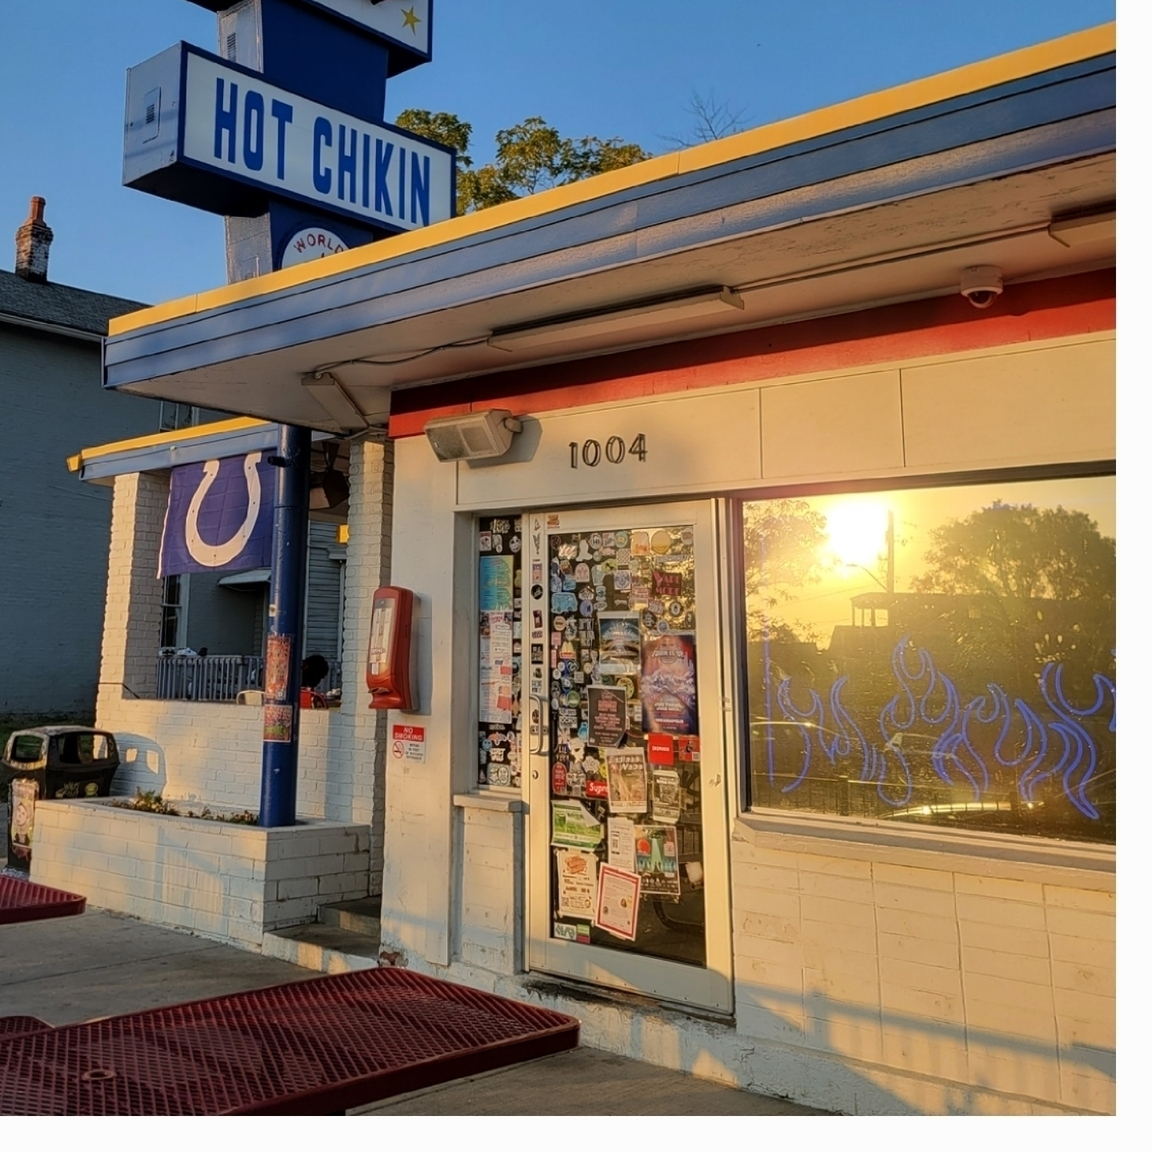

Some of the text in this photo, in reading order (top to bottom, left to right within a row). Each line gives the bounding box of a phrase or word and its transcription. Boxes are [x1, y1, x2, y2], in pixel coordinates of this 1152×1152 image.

[214, 77, 430, 227] HOT CHIKIN
[568, 433, 648, 469] 1004
[394, 732, 422, 740] SMOKING
